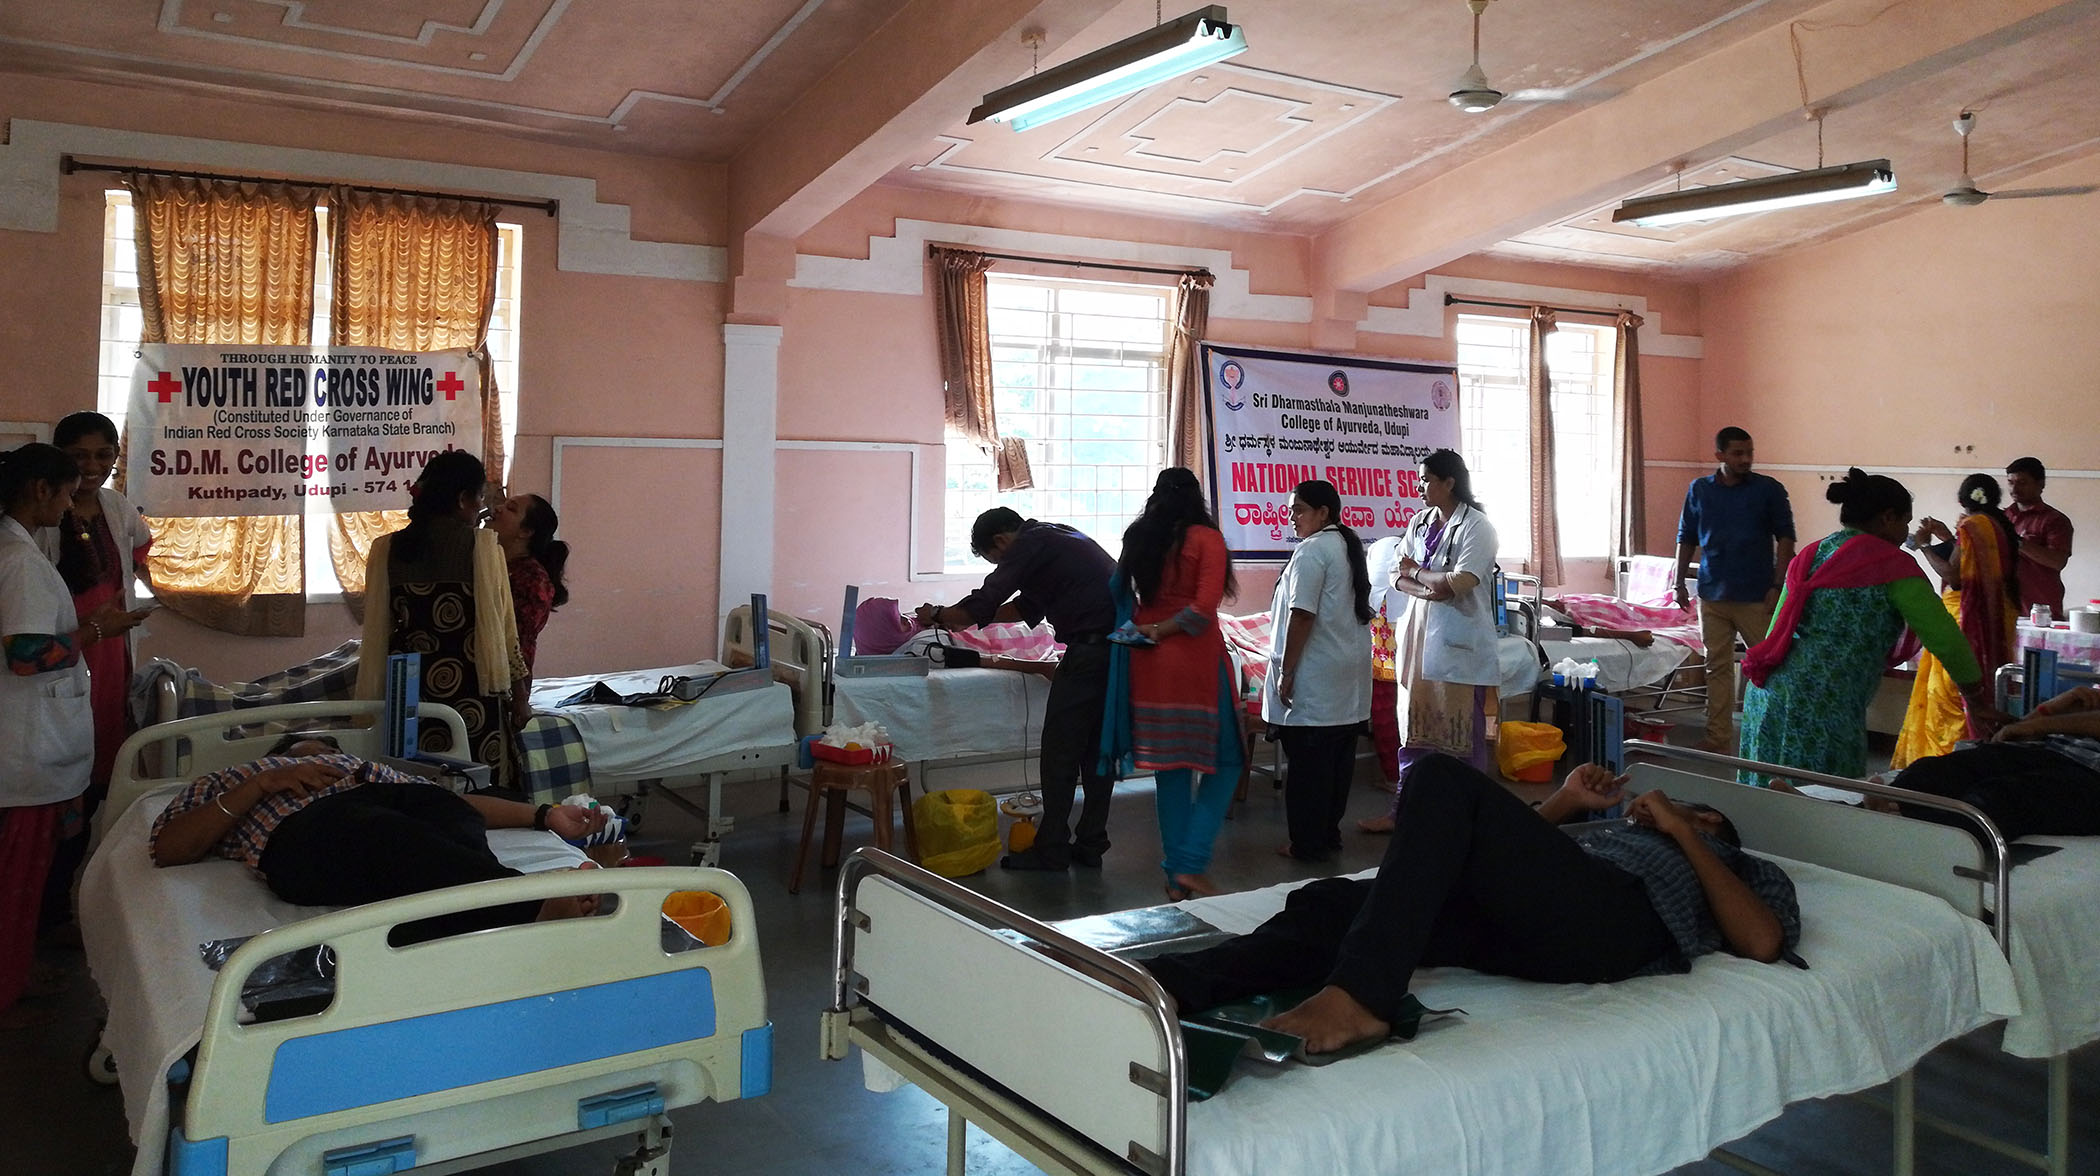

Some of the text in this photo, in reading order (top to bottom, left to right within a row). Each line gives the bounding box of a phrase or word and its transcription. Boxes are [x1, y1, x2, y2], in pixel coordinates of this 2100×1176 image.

[220, 353, 417, 365] THROUGH HUMANITY TO PEACE
[182, 367, 434, 408] YOUTH RED CROSS WING
[213, 408, 413, 425] (Constituted Under Governance of
[1253, 393, 1430, 421] Sri Dharmasthala Manjunatheshwara
[164, 423, 456, 441] Indian Red Cross Society Karnataka State Branch)
[1281, 414, 1410, 438] College of Ayurveda, Udupi
[1224, 433, 1236, 453] ಶ್ರೀ
[150, 443, 466, 479] S.D.M. College of Ayurv
[188, 486, 287, 501] Kuthpady,
[294, 484, 347, 499] Udupi
[364, 481, 397, 494] 574
[1326, 466, 1393, 497] SERVICE
[1397, 470, 1420, 498] SC
